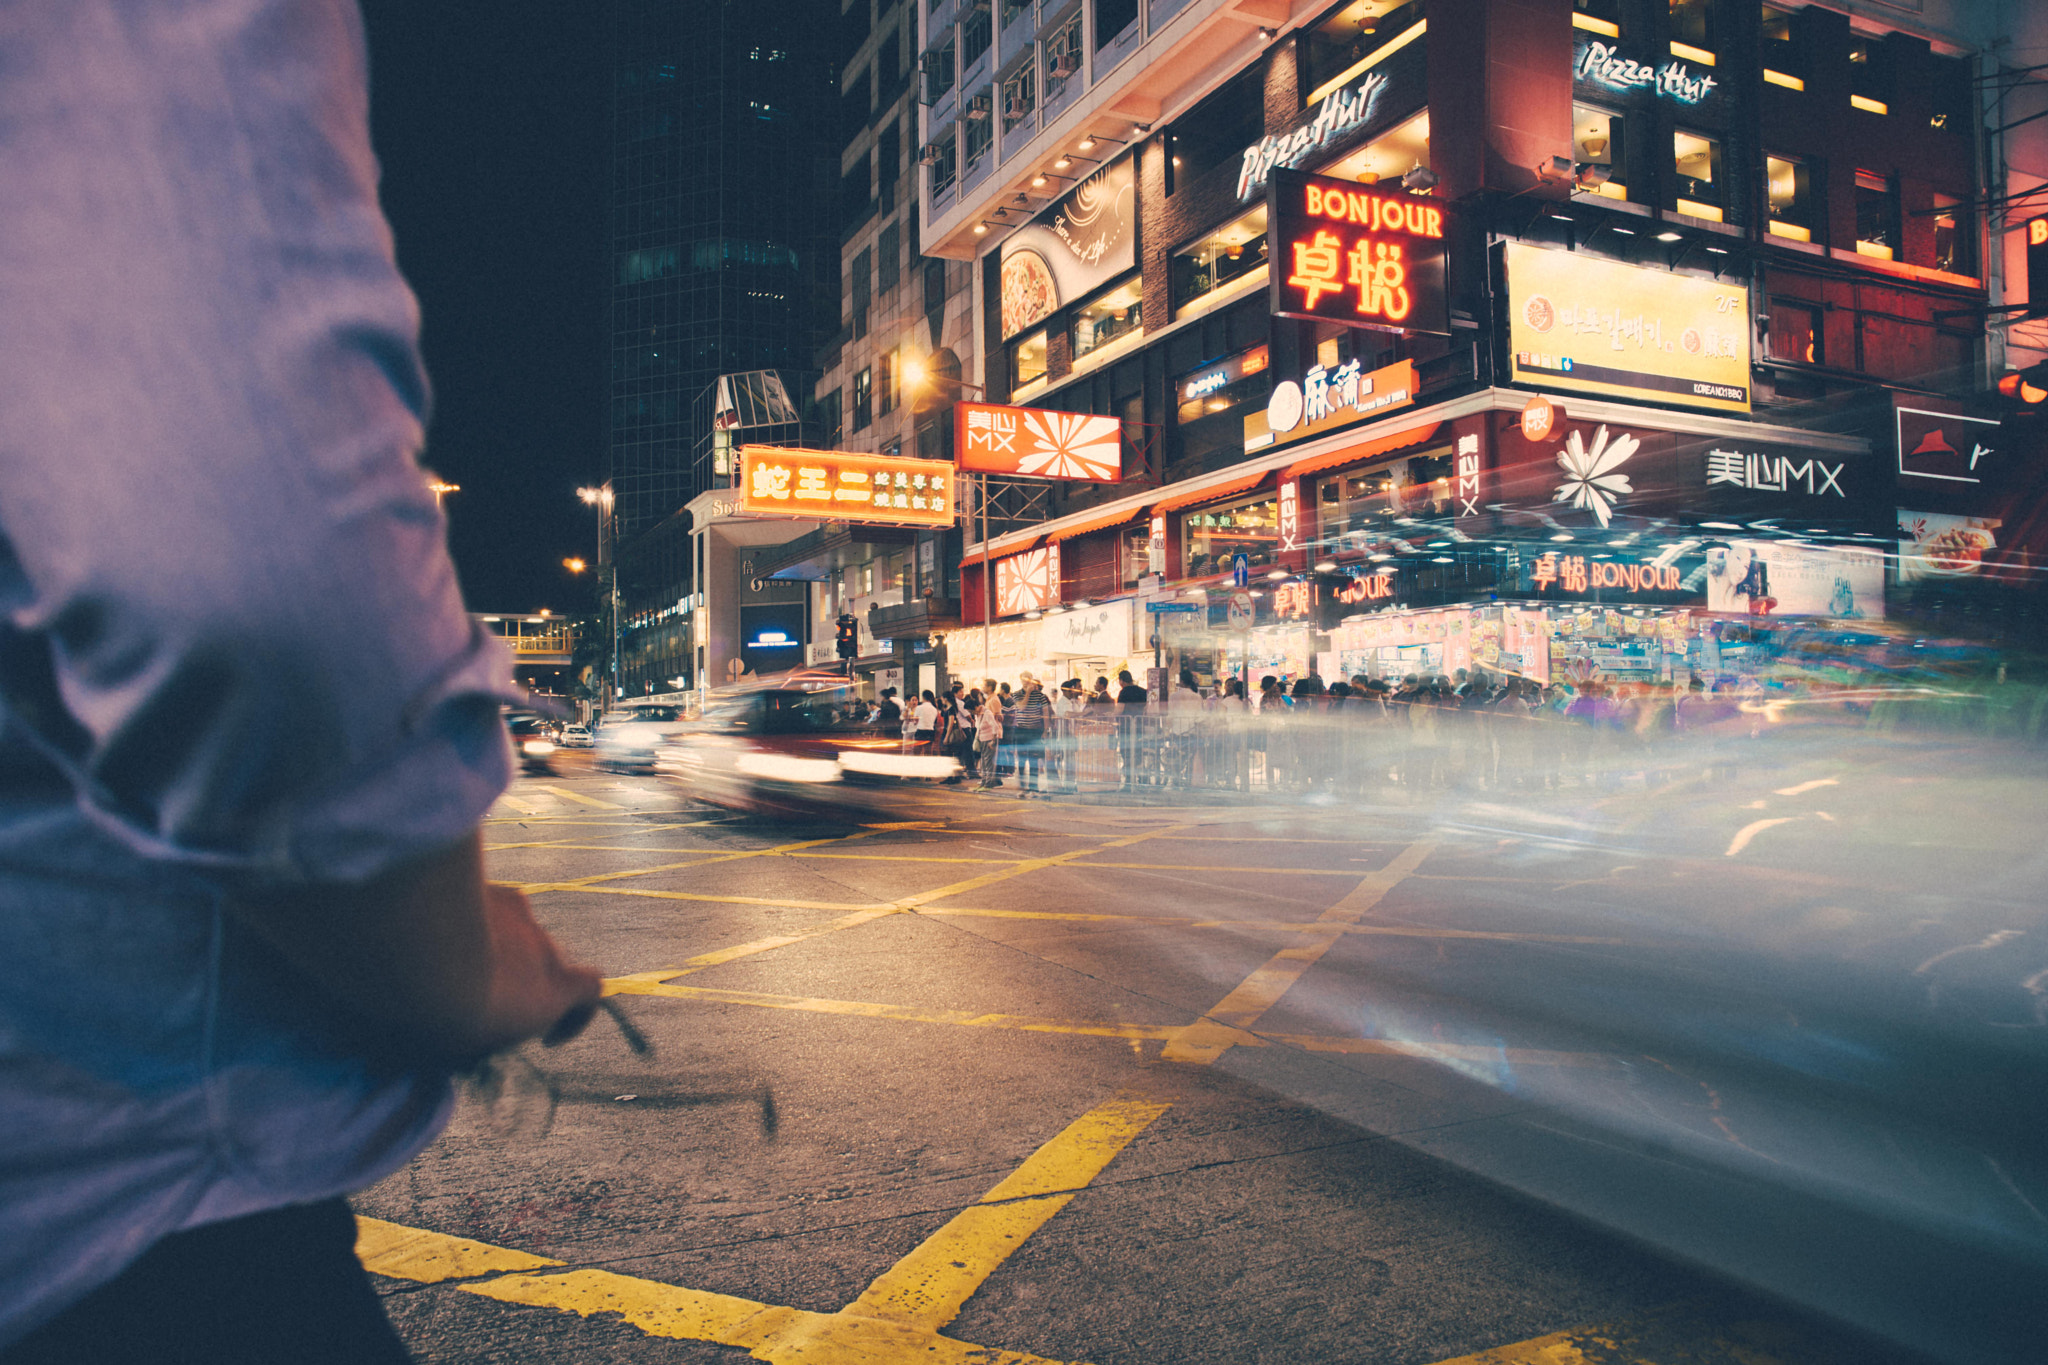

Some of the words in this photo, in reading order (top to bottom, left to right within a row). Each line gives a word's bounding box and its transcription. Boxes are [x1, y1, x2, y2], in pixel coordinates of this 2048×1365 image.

[1582, 40, 1655, 86] Pizza
[1660, 61, 1718, 100] Hut
[1236, 125, 1312, 200] Pizza
[1313, 72, 1387, 146] Hut
[1306, 184, 1443, 238] BONJOUR
[1715, 295, 1739, 315] 2/F
[1693, 383, 1716, 396] KOREA
[1728, 388, 1743, 400] BBQ
[968, 410, 1016, 433] 美心
[1526, 417, 1548, 433] MX
[968, 430, 1016, 453] MX
[752, 462, 871, 502] 蛇王二
[1590, 561, 1683, 592] BONJOUR
